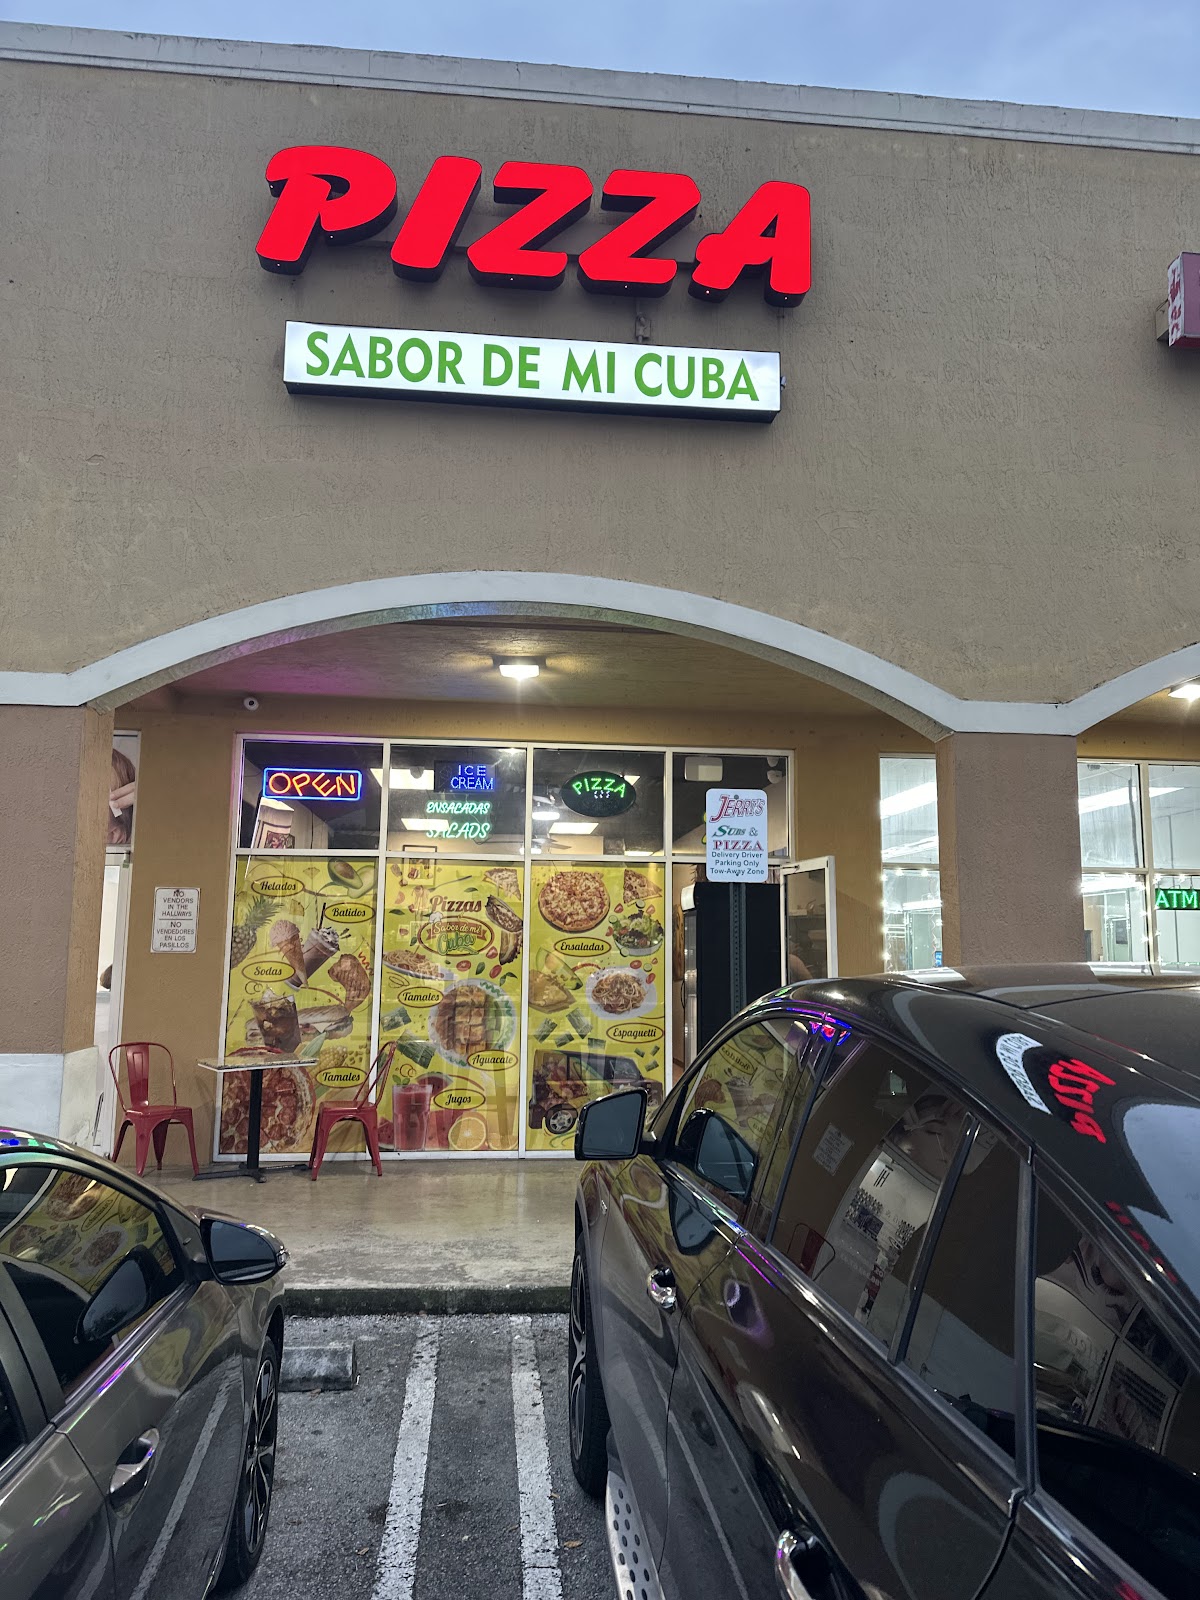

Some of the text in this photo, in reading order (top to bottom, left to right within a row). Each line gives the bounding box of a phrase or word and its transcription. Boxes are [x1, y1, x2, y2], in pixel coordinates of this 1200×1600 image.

[256, 145, 812, 297] PIZZA
[305, 331, 760, 402] SABOR DE MI CUBA
[458, 764, 487, 776] ICE
[268, 772, 356, 797] OPEN
[450, 776, 494, 790] CREAM
[572, 777, 626, 798] PIZZA
[426, 801, 491, 815] ENSALADAS
[749, 827, 759, 837] &
[712, 839, 765, 851] PIZZA
[711, 851, 740, 859] Delivery
[714, 860, 742, 868] Parking
[710, 868, 746, 876] Tow-Away
[260, 881, 297, 891] Helados
[430, 894, 482, 912] Pizzas
[1155, 890, 1198, 909] ATM
[331, 907, 367, 918] Batidos
[433, 920, 459, 934] Sabor
[437, 930, 477, 957] Cuba
[560, 941, 605, 952] Ensaladas
[253, 966, 283, 977] Sodas
[402, 992, 440, 1002] Tamales
[612, 1028, 657, 1040] Espaguetti
[472, 1054, 514, 1067] Aguacate
[322, 1071, 361, 1082] Tamales
[444, 1093, 472, 1106] Jugos
